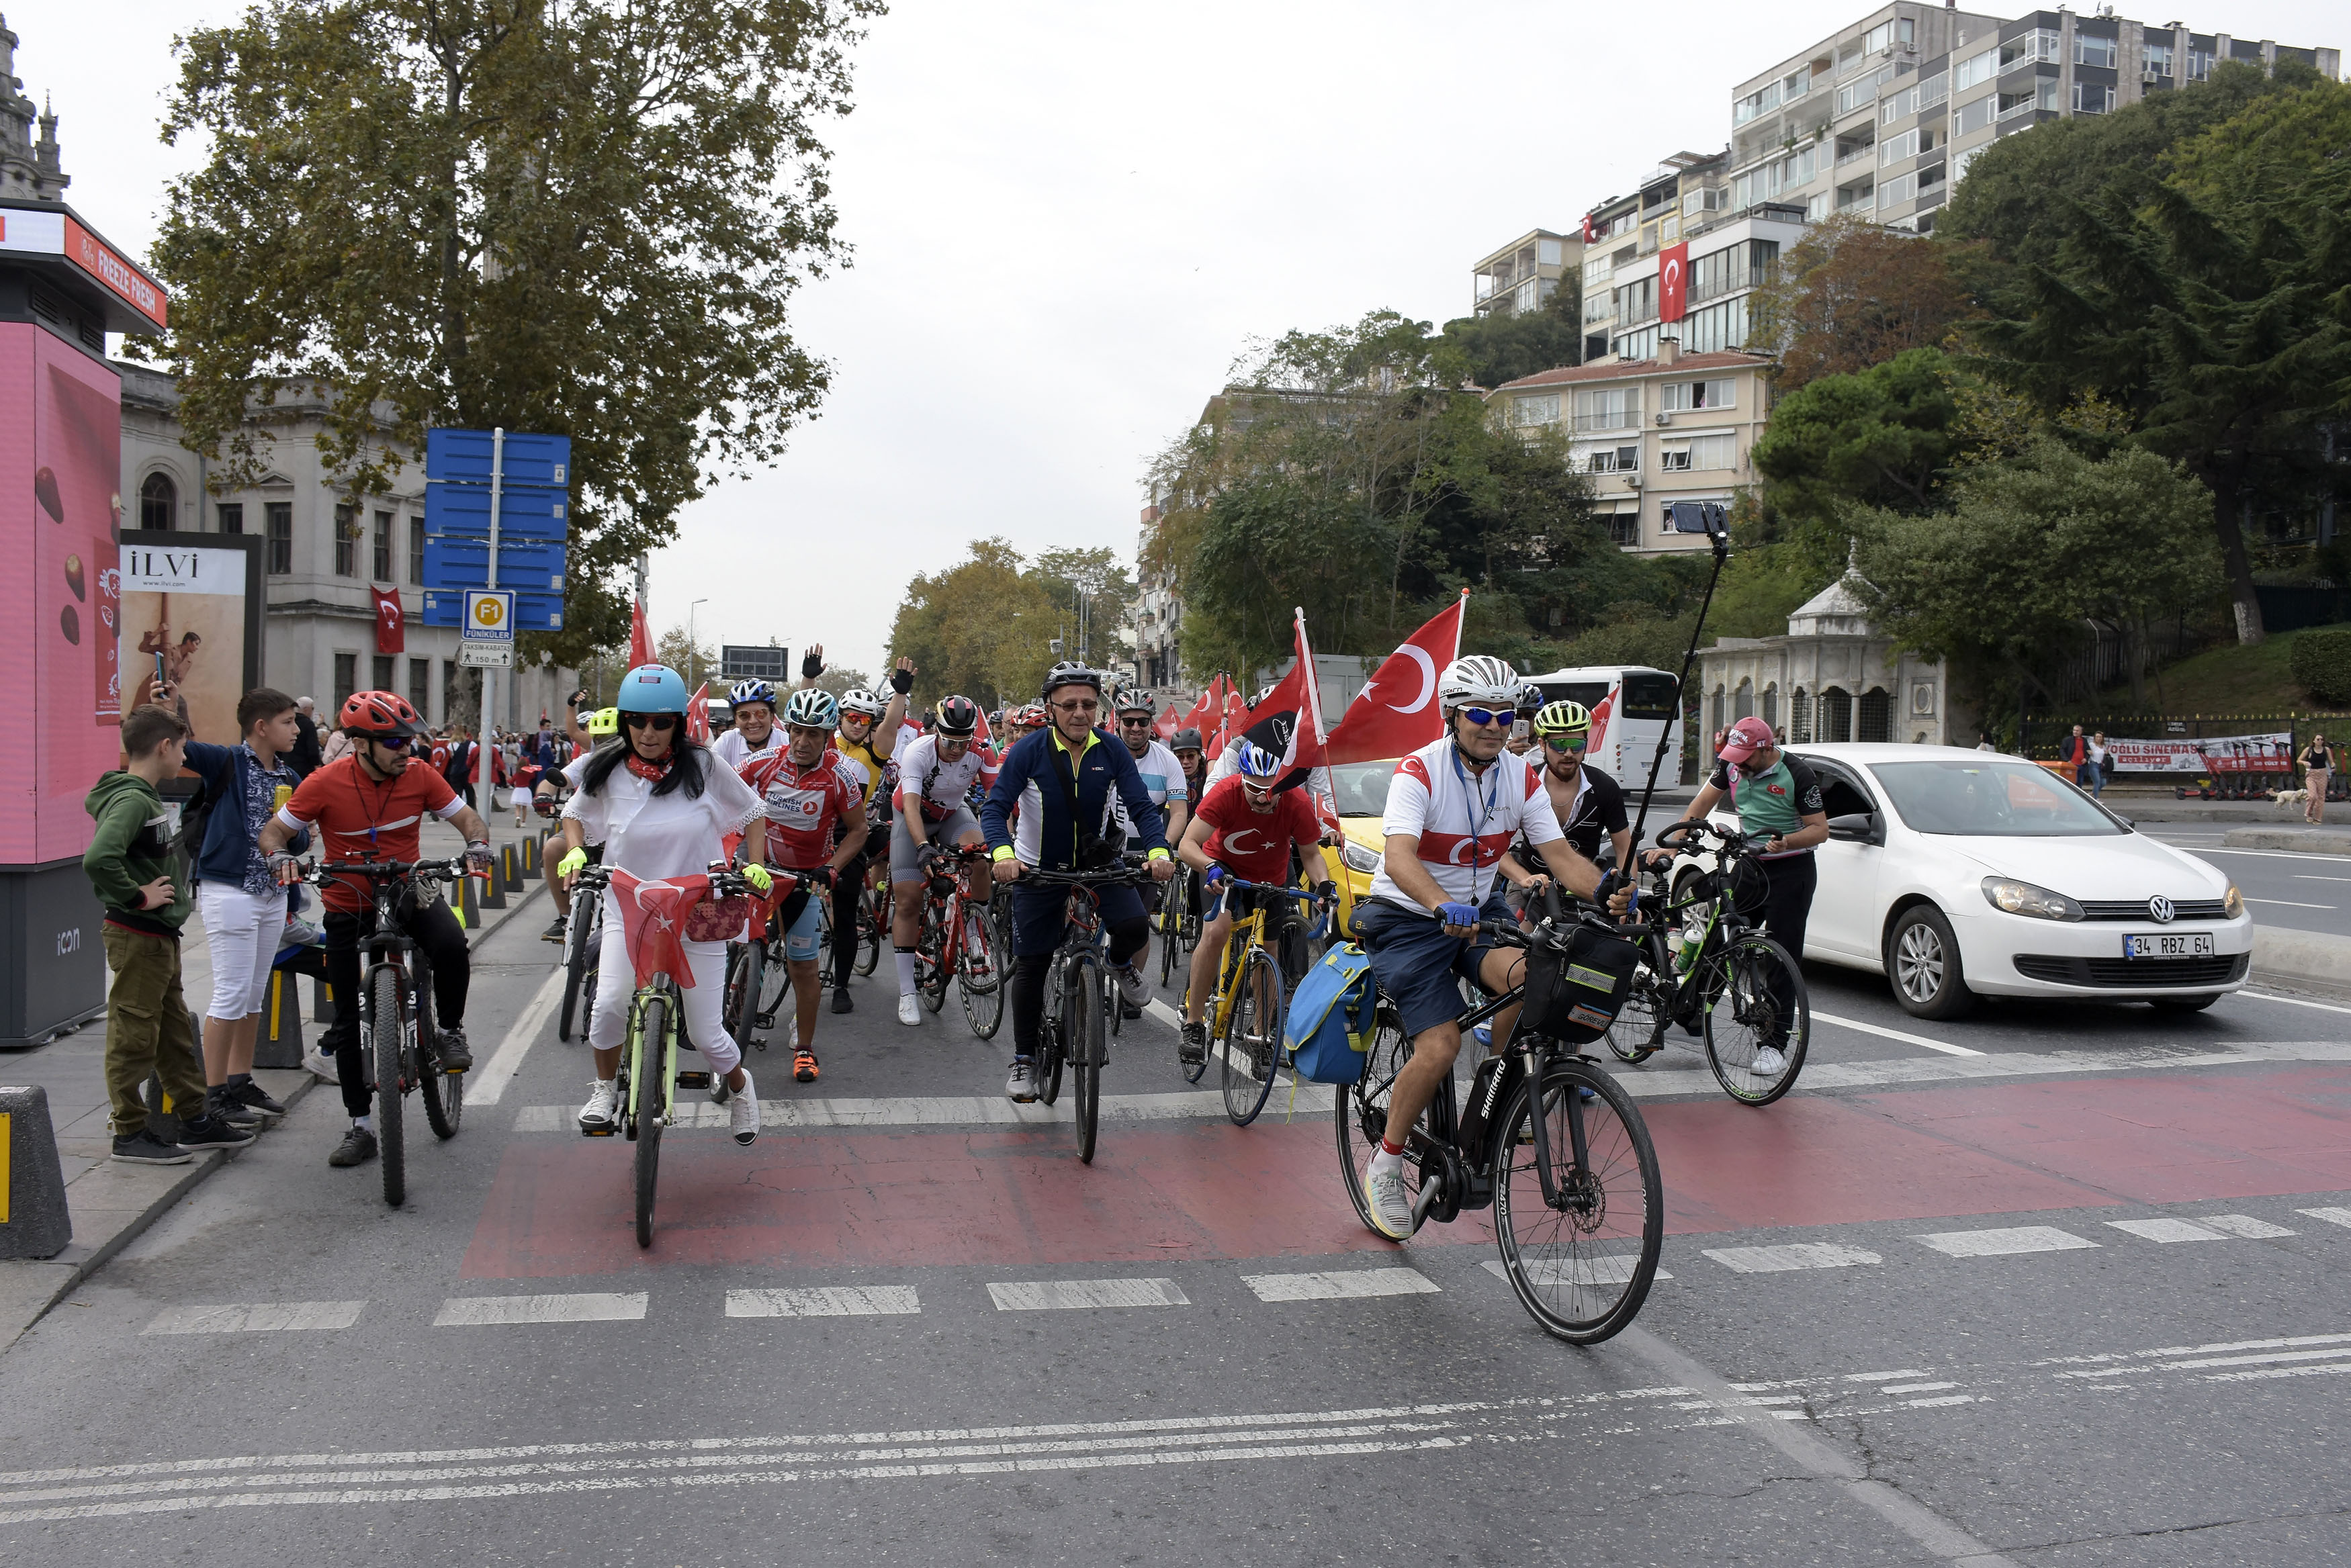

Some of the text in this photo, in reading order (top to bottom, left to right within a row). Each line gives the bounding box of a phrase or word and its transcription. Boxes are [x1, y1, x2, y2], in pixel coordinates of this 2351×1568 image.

[98, 248, 130, 295] FREEZE
[131, 275, 156, 314] FRESH
[480, 604, 498, 618] F1
[466, 629, 510, 639] FÜNİKÜLER
[747, 751, 774, 764] AIRLINES
[833, 765, 852, 788] AIRLINES
[837, 762, 856, 784] TURKISH
[766, 797, 801, 812] AIRLINES
[768, 792, 802, 806] TURKISH
[57, 927, 80, 956] icon
[2135, 937, 2209, 954] 34 RBZ 64
[1481, 1059, 1506, 1119] SHIMANO
